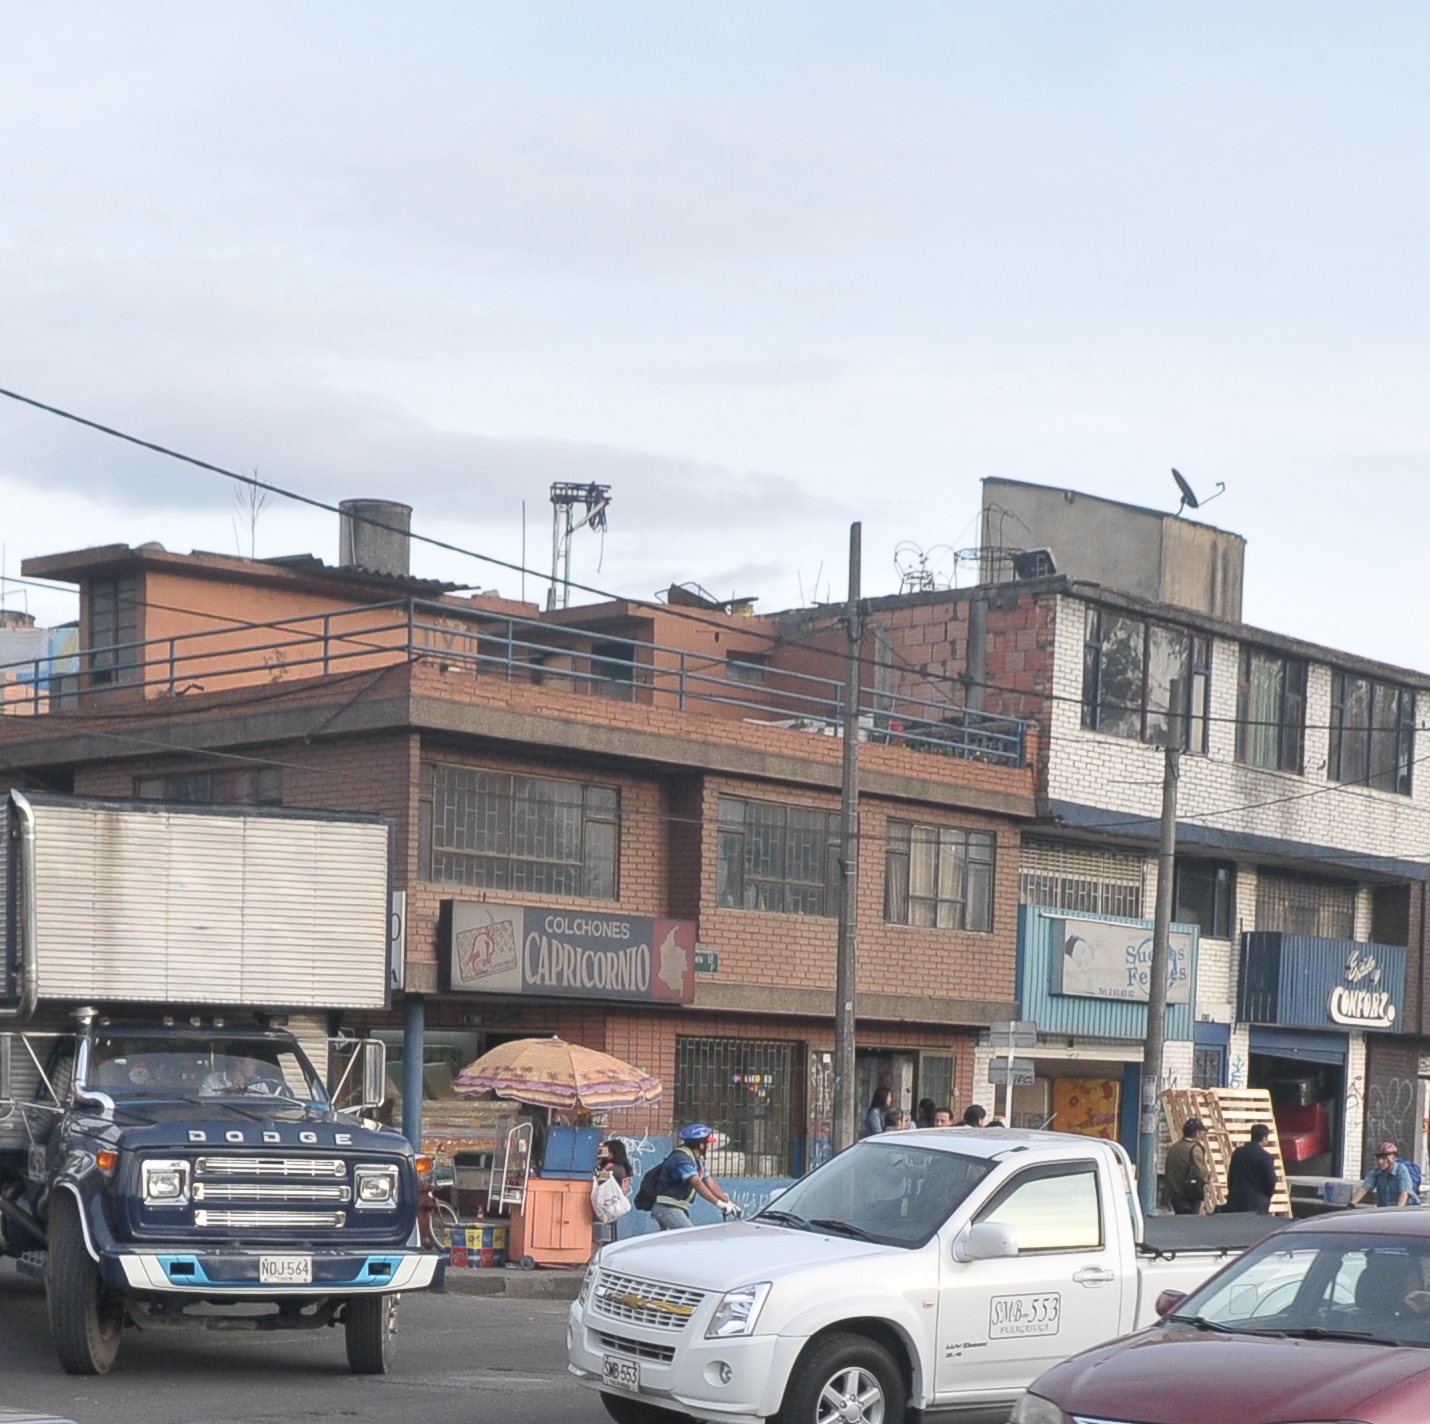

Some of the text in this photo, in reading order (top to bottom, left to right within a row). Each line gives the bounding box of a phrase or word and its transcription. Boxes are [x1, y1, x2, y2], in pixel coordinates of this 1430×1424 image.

[544, 915, 631, 940] COLCHONES
[524, 931, 651, 992] CAPRICORNIO
[188, 1130, 353, 1146] DODGE
[261, 1260, 309, 1276] NDJ-564
[991, 1297, 1059, 1326] SMB-553
